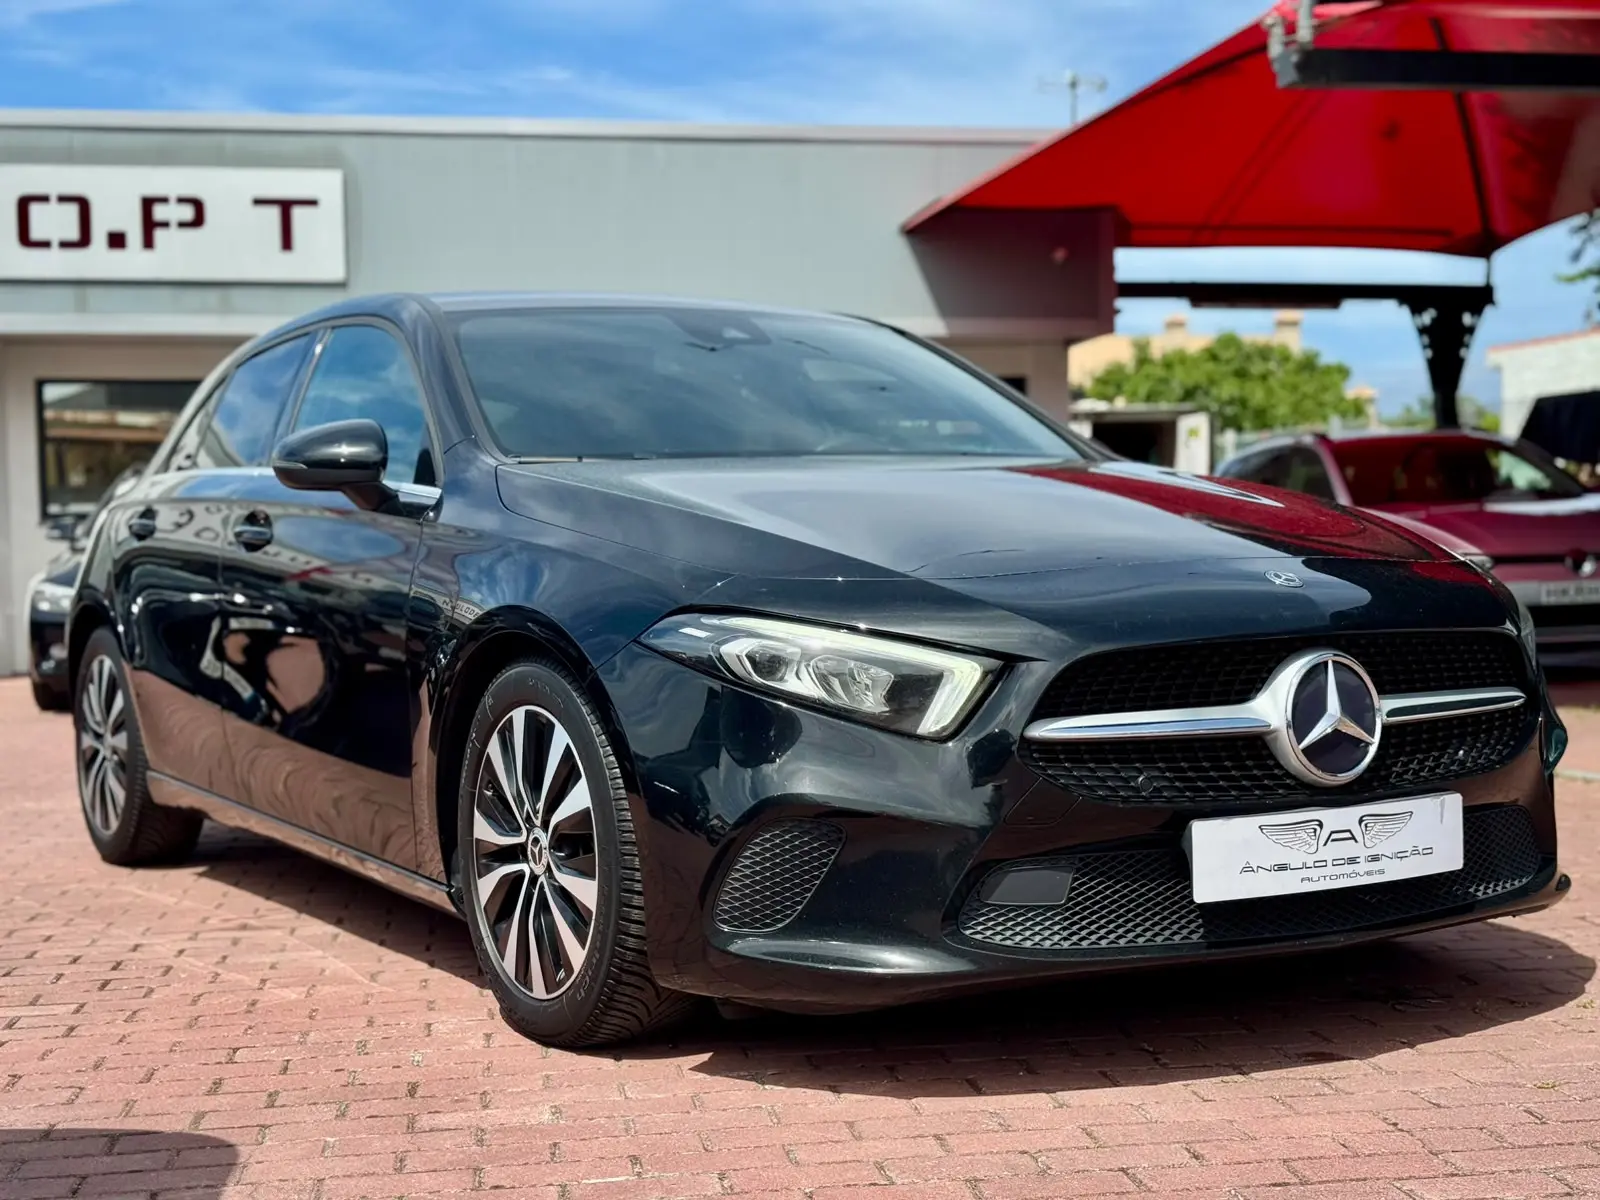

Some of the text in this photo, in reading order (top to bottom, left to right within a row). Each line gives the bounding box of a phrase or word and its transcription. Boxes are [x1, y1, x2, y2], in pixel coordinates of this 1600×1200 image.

[1239, 845, 1434, 875] ÂNGULO DE IGNIÇÃO
[1300, 868, 1386, 883] AUTOMÓVEIS
